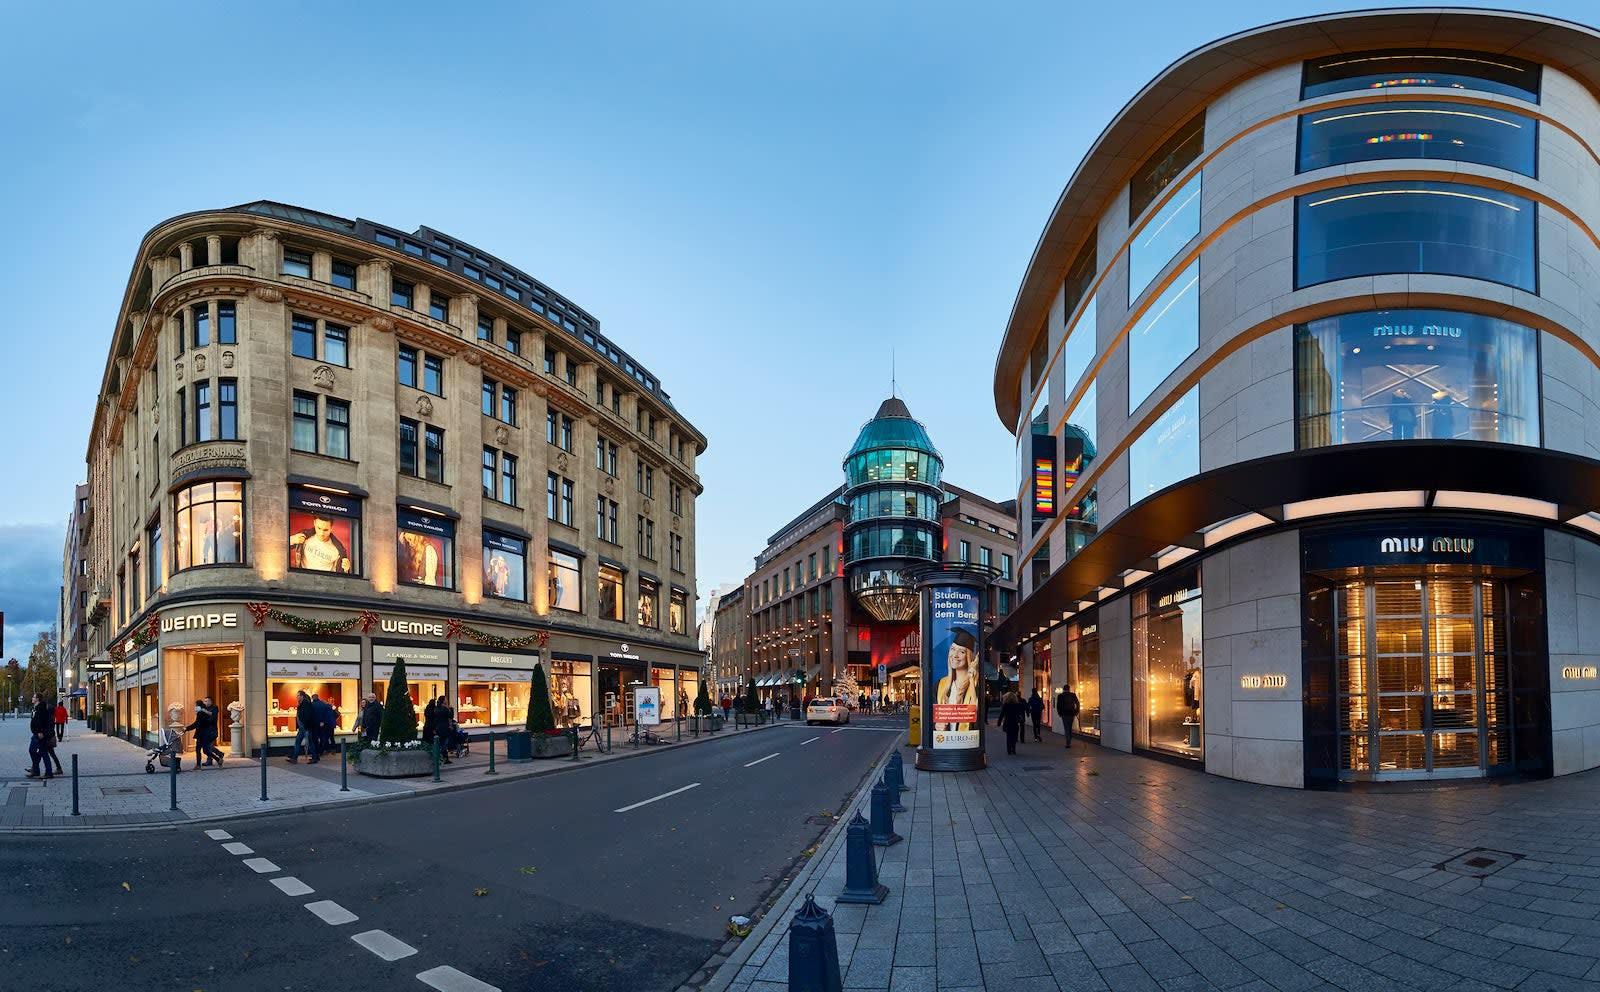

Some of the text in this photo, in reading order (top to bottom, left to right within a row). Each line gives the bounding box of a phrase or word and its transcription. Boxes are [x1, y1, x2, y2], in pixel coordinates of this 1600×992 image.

[1373, 325, 1462, 338] MIU MIU
[322, 504, 348, 513] TAILOR
[407, 520, 444, 533] TOM TAILOR
[1380, 537, 1475, 553] MIU MIU
[934, 591, 972, 600] Studium
[935, 601, 963, 609] neben
[161, 612, 237, 633] WEMPE
[381, 620, 443, 637] WEMPE
[301, 647, 330, 656] ROLEX
